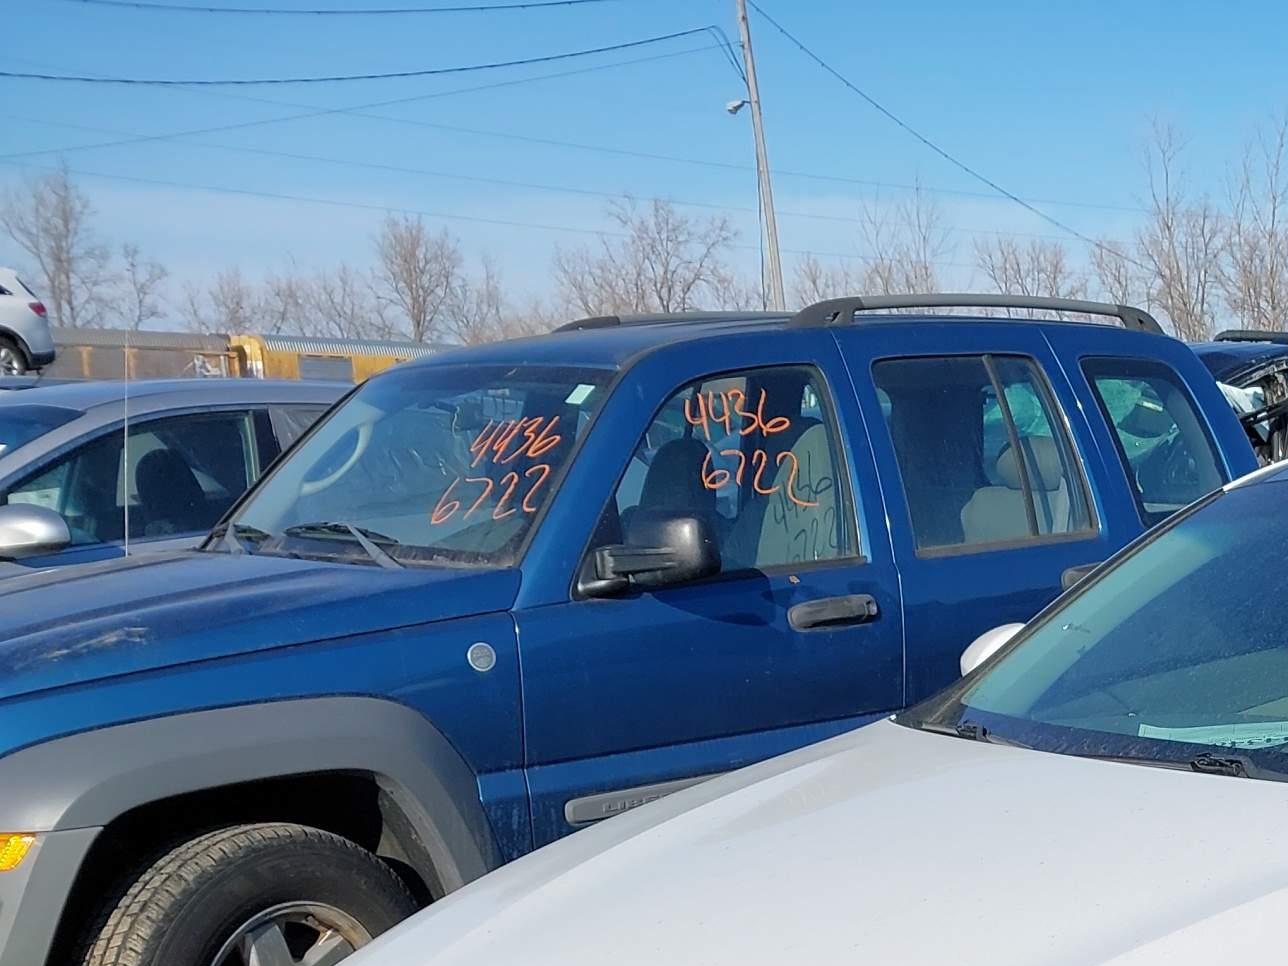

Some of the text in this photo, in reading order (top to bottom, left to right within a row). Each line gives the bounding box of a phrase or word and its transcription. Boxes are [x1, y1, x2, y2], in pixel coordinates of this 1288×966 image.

[683, 388, 790, 438] 4436
[470, 415, 561, 469] 4436
[430, 464, 551, 525] 6722
[701, 448, 820, 507] 6722
